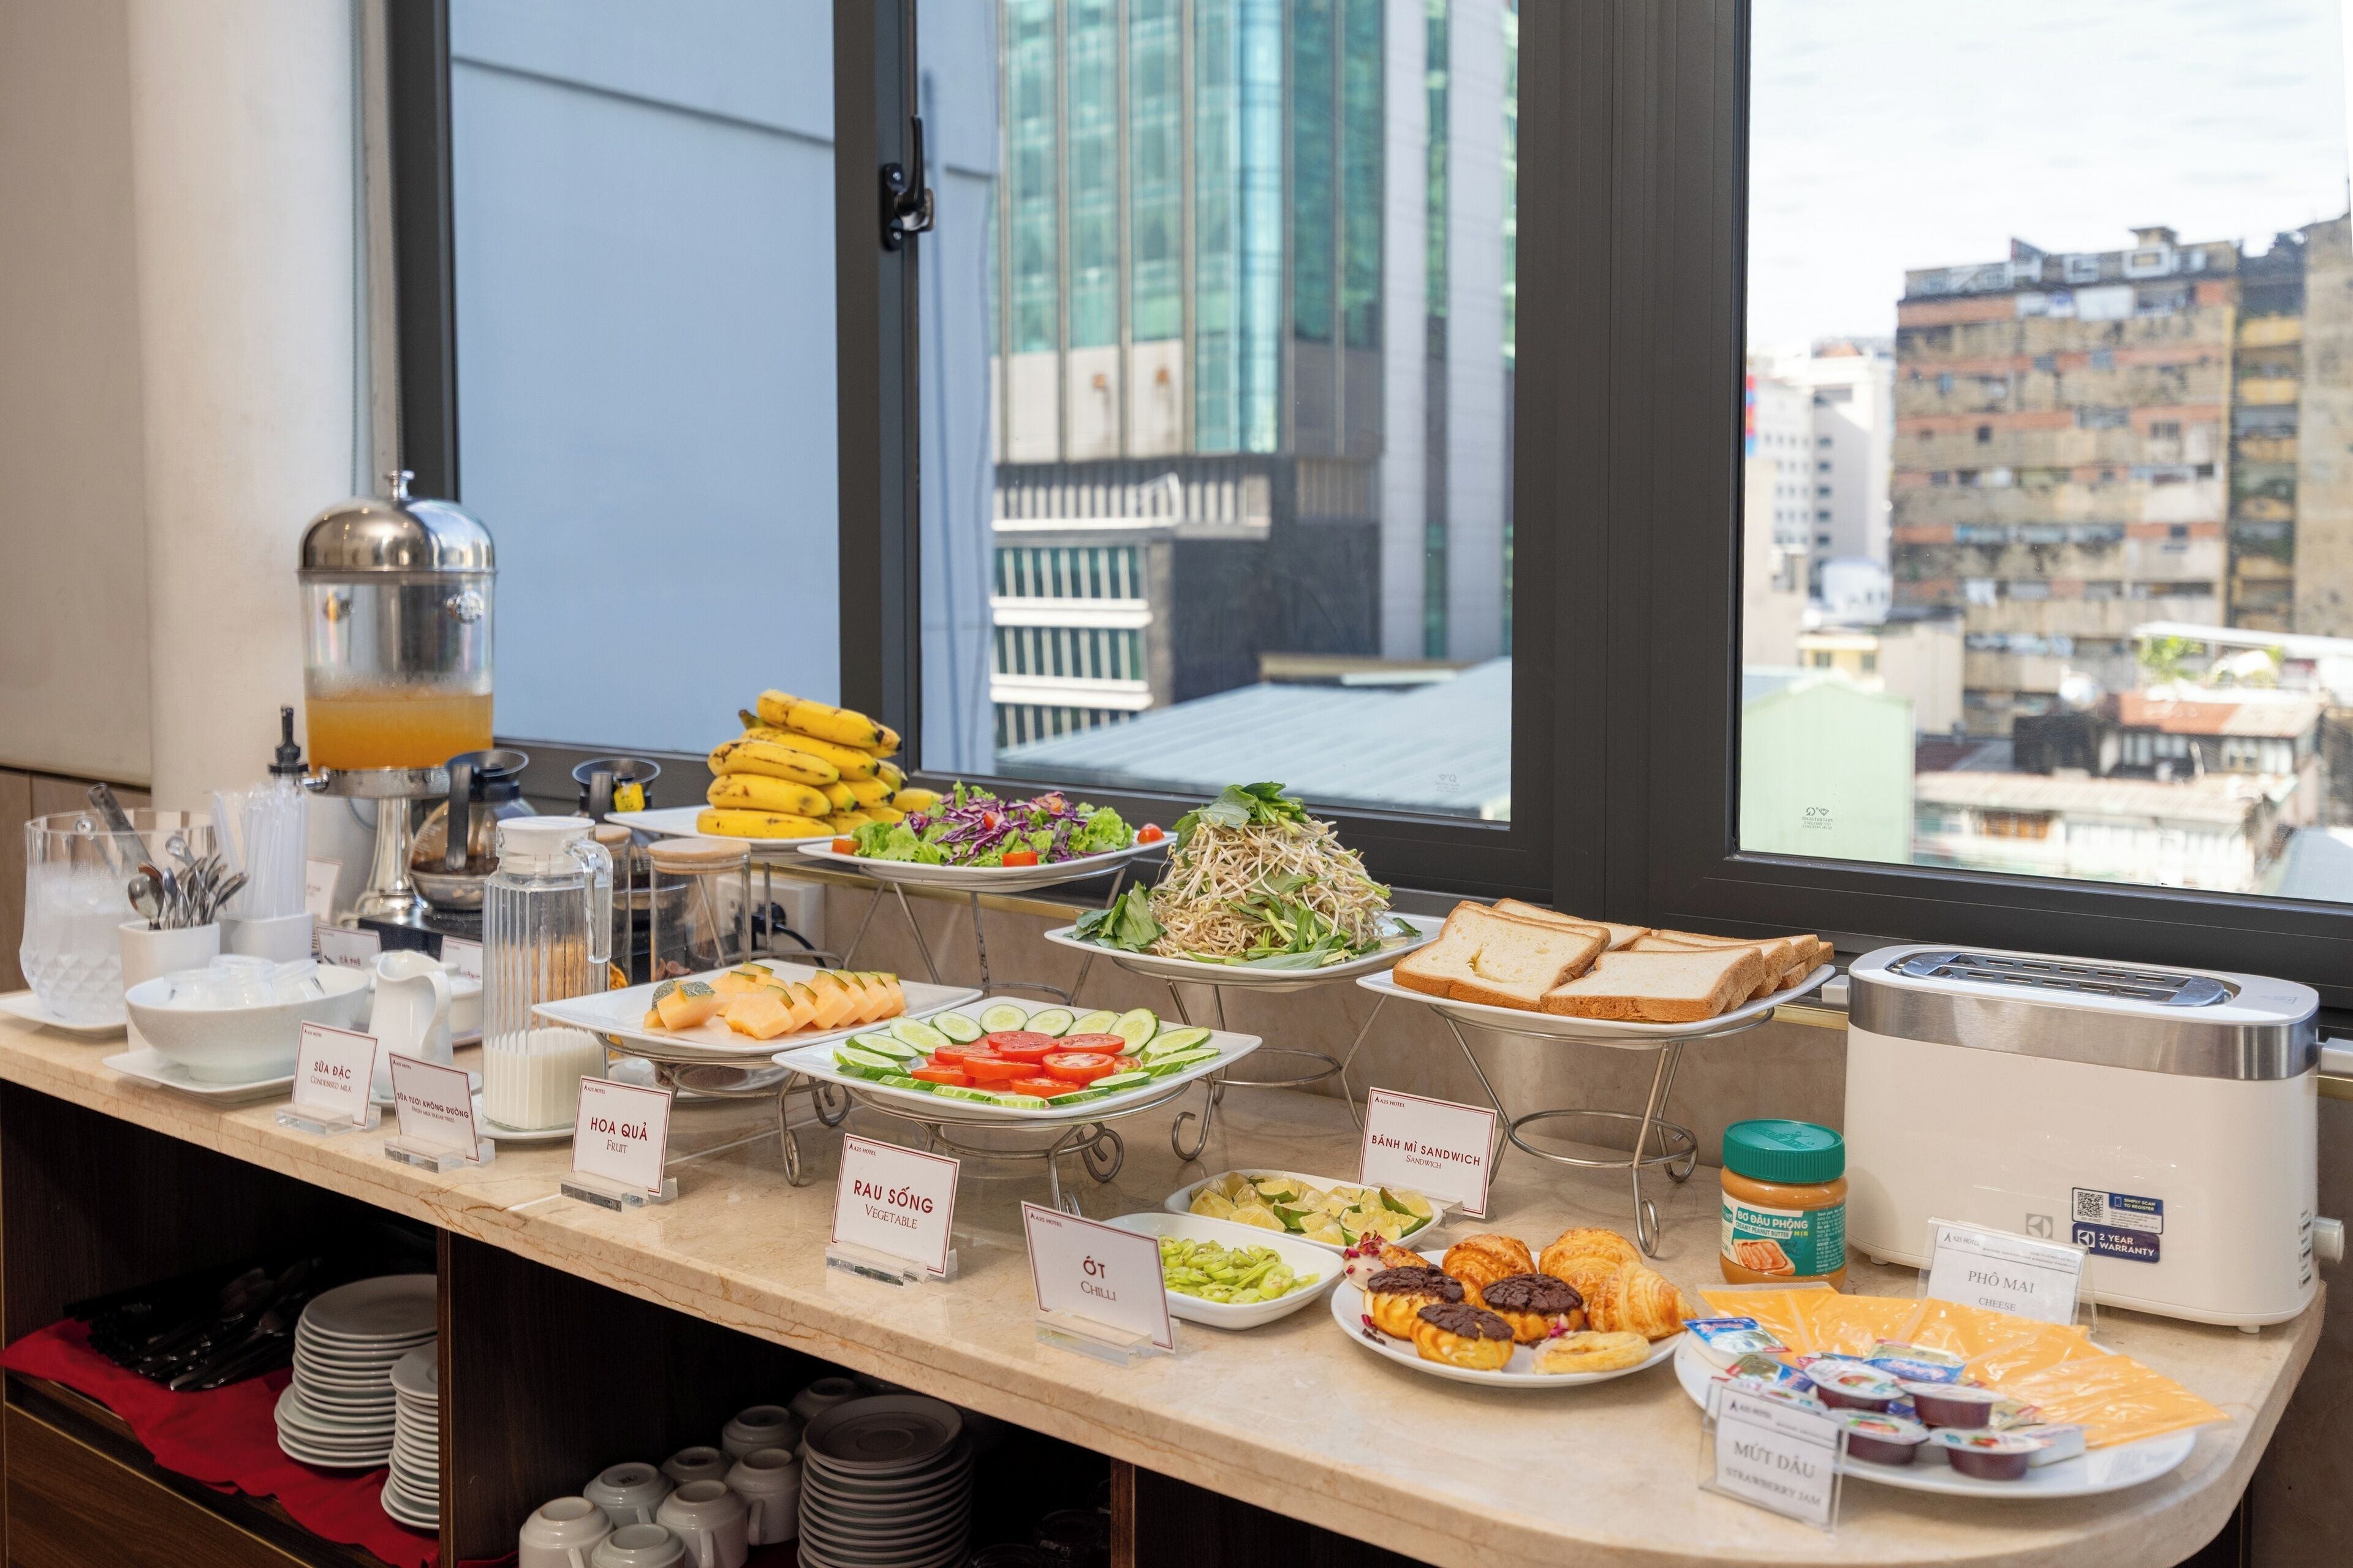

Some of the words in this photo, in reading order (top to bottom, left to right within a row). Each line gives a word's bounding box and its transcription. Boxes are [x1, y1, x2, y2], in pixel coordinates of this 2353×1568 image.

[333, 1066, 351, 1080] ĐẶC
[423, 1101, 444, 1112] KHÔNG
[591, 1117, 616, 1135] HOA
[621, 1121, 648, 1141] QUẢ
[1371, 1134, 1400, 1149] BÁNH
[1404, 1140, 1417, 1153] MÌ
[1420, 1145, 1480, 1166] SANDWICH
[854, 1180, 882, 1200] RAU
[888, 1186, 933, 1214] SỐNG
[1046, 1219, 1063, 1227] HOTEL
[1750, 1214, 1770, 1227] ĐẬU
[1772, 1218, 1808, 1230] PHỘNG
[1752, 1227, 1770, 1236] PEANUT
[2108, 1234, 2134, 1245] YEAR
[1963, 1238, 1980, 1246] HOTEL
[2099, 1241, 2155, 1257] WARRANTY
[1083, 1256, 1105, 1279] ỚT
[1968, 1270, 1999, 1287] PHÔ
[2003, 1278, 2034, 1294] MAI
[1979, 1297, 2017, 1312] CHEESE
[1734, 1441, 1773, 1465] MỨT
[1778, 1455, 1816, 1479] DÂU
[1726, 1467, 1796, 1497] STRAWBERRY
